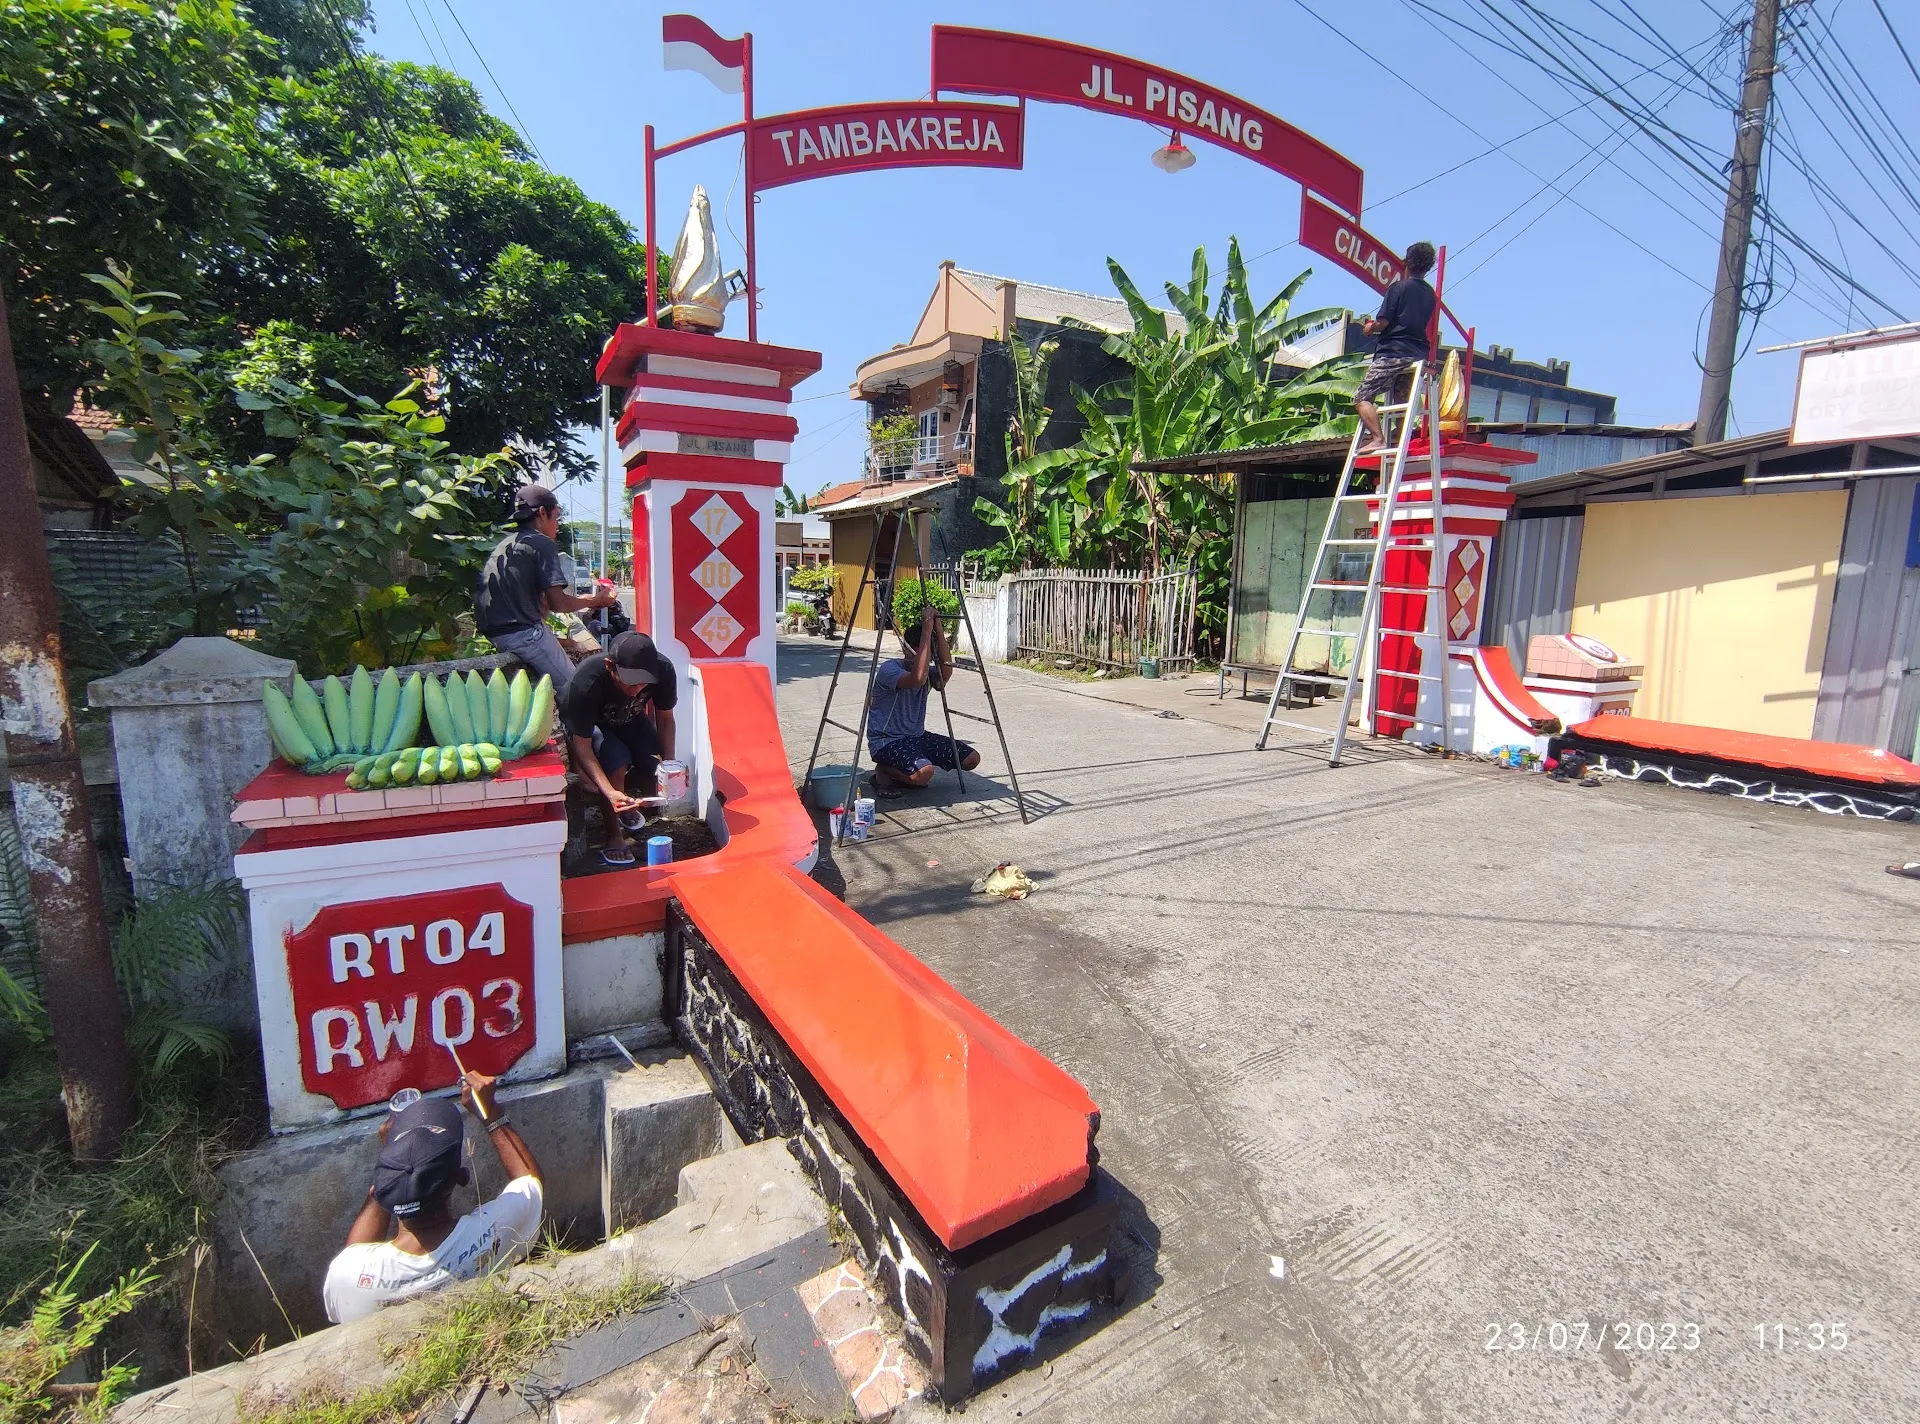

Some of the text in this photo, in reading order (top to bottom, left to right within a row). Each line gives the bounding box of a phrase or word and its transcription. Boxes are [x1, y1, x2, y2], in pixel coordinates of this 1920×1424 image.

[1080, 65, 1264, 153] JL. PISANG
[771, 117, 1005, 167] TAMBAKREJA
[703, 508, 727, 536] 17
[701, 561, 731, 588] 08
[700, 616, 731, 643] 45
[311, 994, 419, 1075] RW
